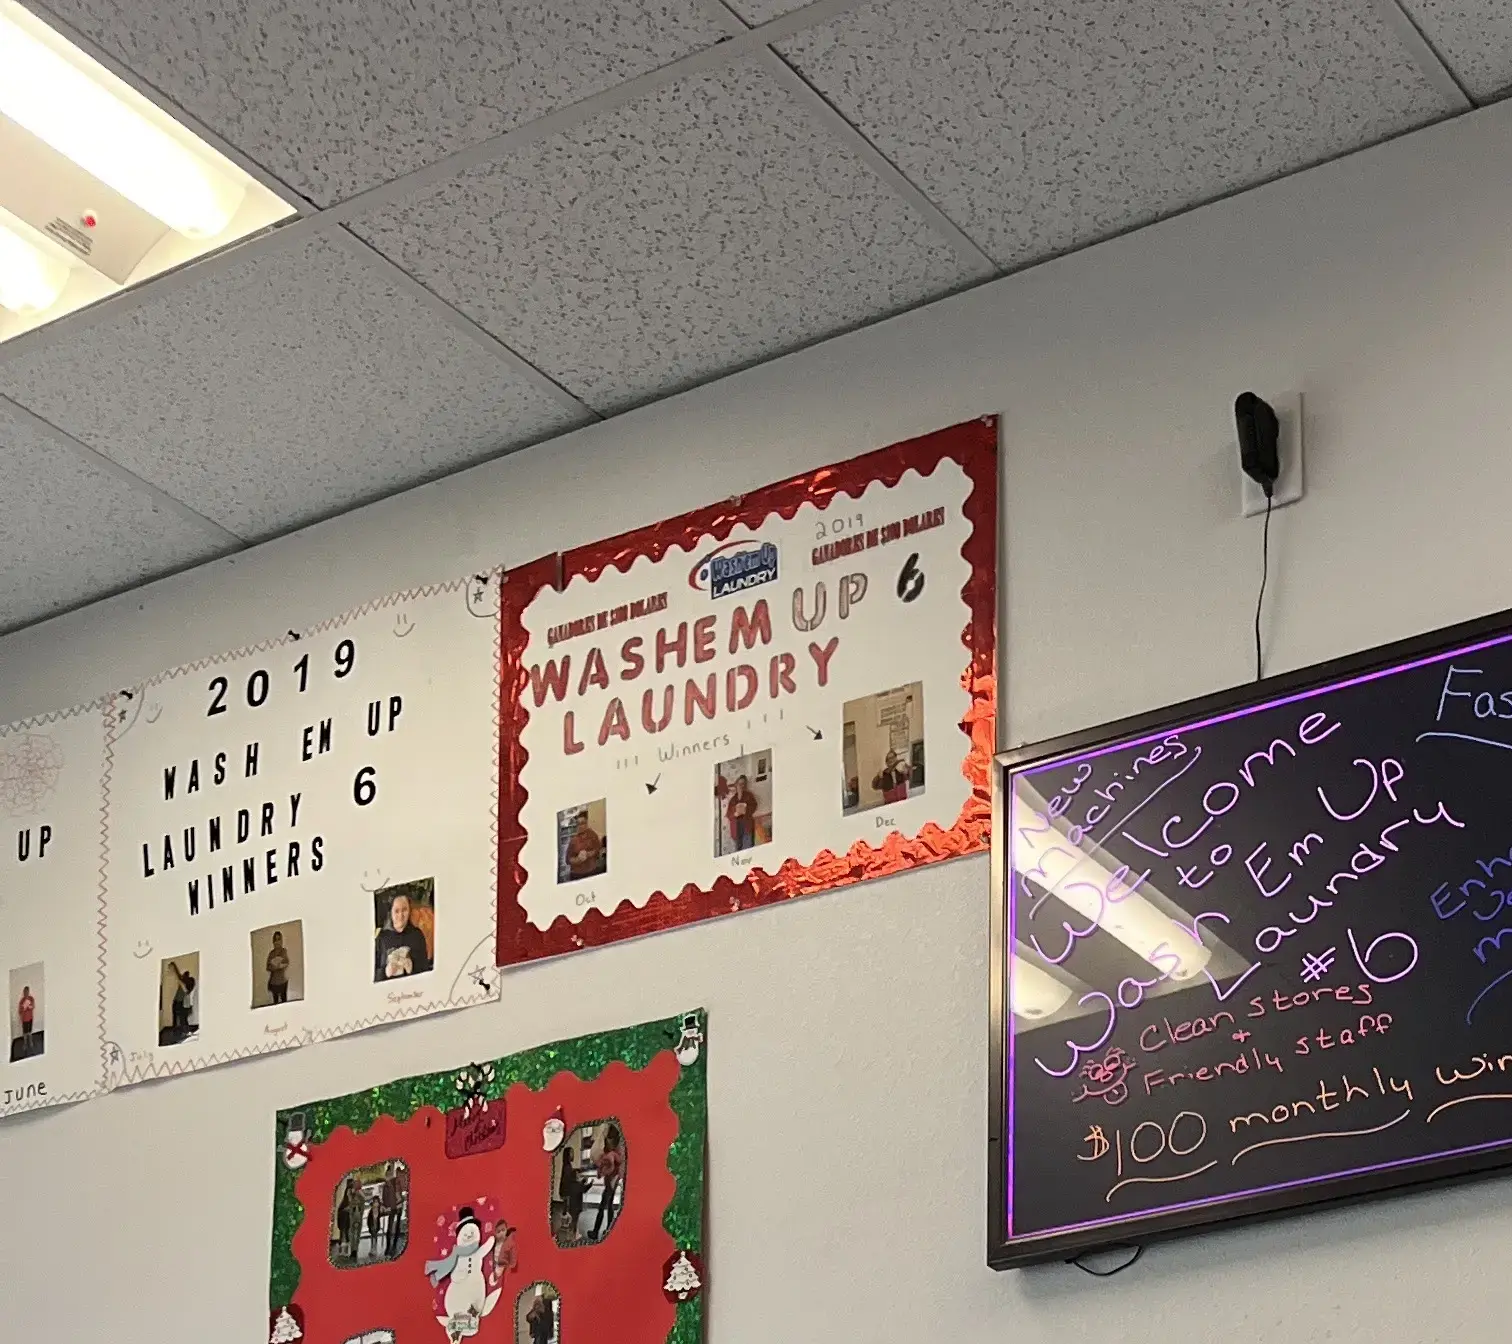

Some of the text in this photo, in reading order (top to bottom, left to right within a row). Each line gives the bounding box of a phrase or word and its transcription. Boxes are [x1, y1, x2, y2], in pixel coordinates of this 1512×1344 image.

[815, 513, 864, 540] 2019
[713, 567, 776, 597] LAUNDRY
[791, 572, 868, 633] UP
[896, 552, 925, 603] 6
[206, 638, 356, 717] 2019
[563, 637, 840, 757] LAUNDRY
[163, 695, 403, 801] WASH EM UP
[658, 733, 730, 763] Winners
[142, 765, 377, 877] LAUNDRY 6
[875, 815, 897, 829] Dec
[1018, 763, 1093, 849] New
[18, 825, 52, 861] UP
[731, 854, 754, 868] Nov
[1176, 843, 1234, 891] to
[1245, 830, 1325, 899] Em
[188, 835, 325, 916] WINNERS
[575, 891, 597, 907] Oct
[1300, 927, 1420, 984] #6
[1139, 1012, 1233, 1053] Clean
[1143, 1014, 1393, 1096] Friendly staff
[1077, 1111, 1207, 1175] $100
[1229, 1069, 1414, 1133] monthly
